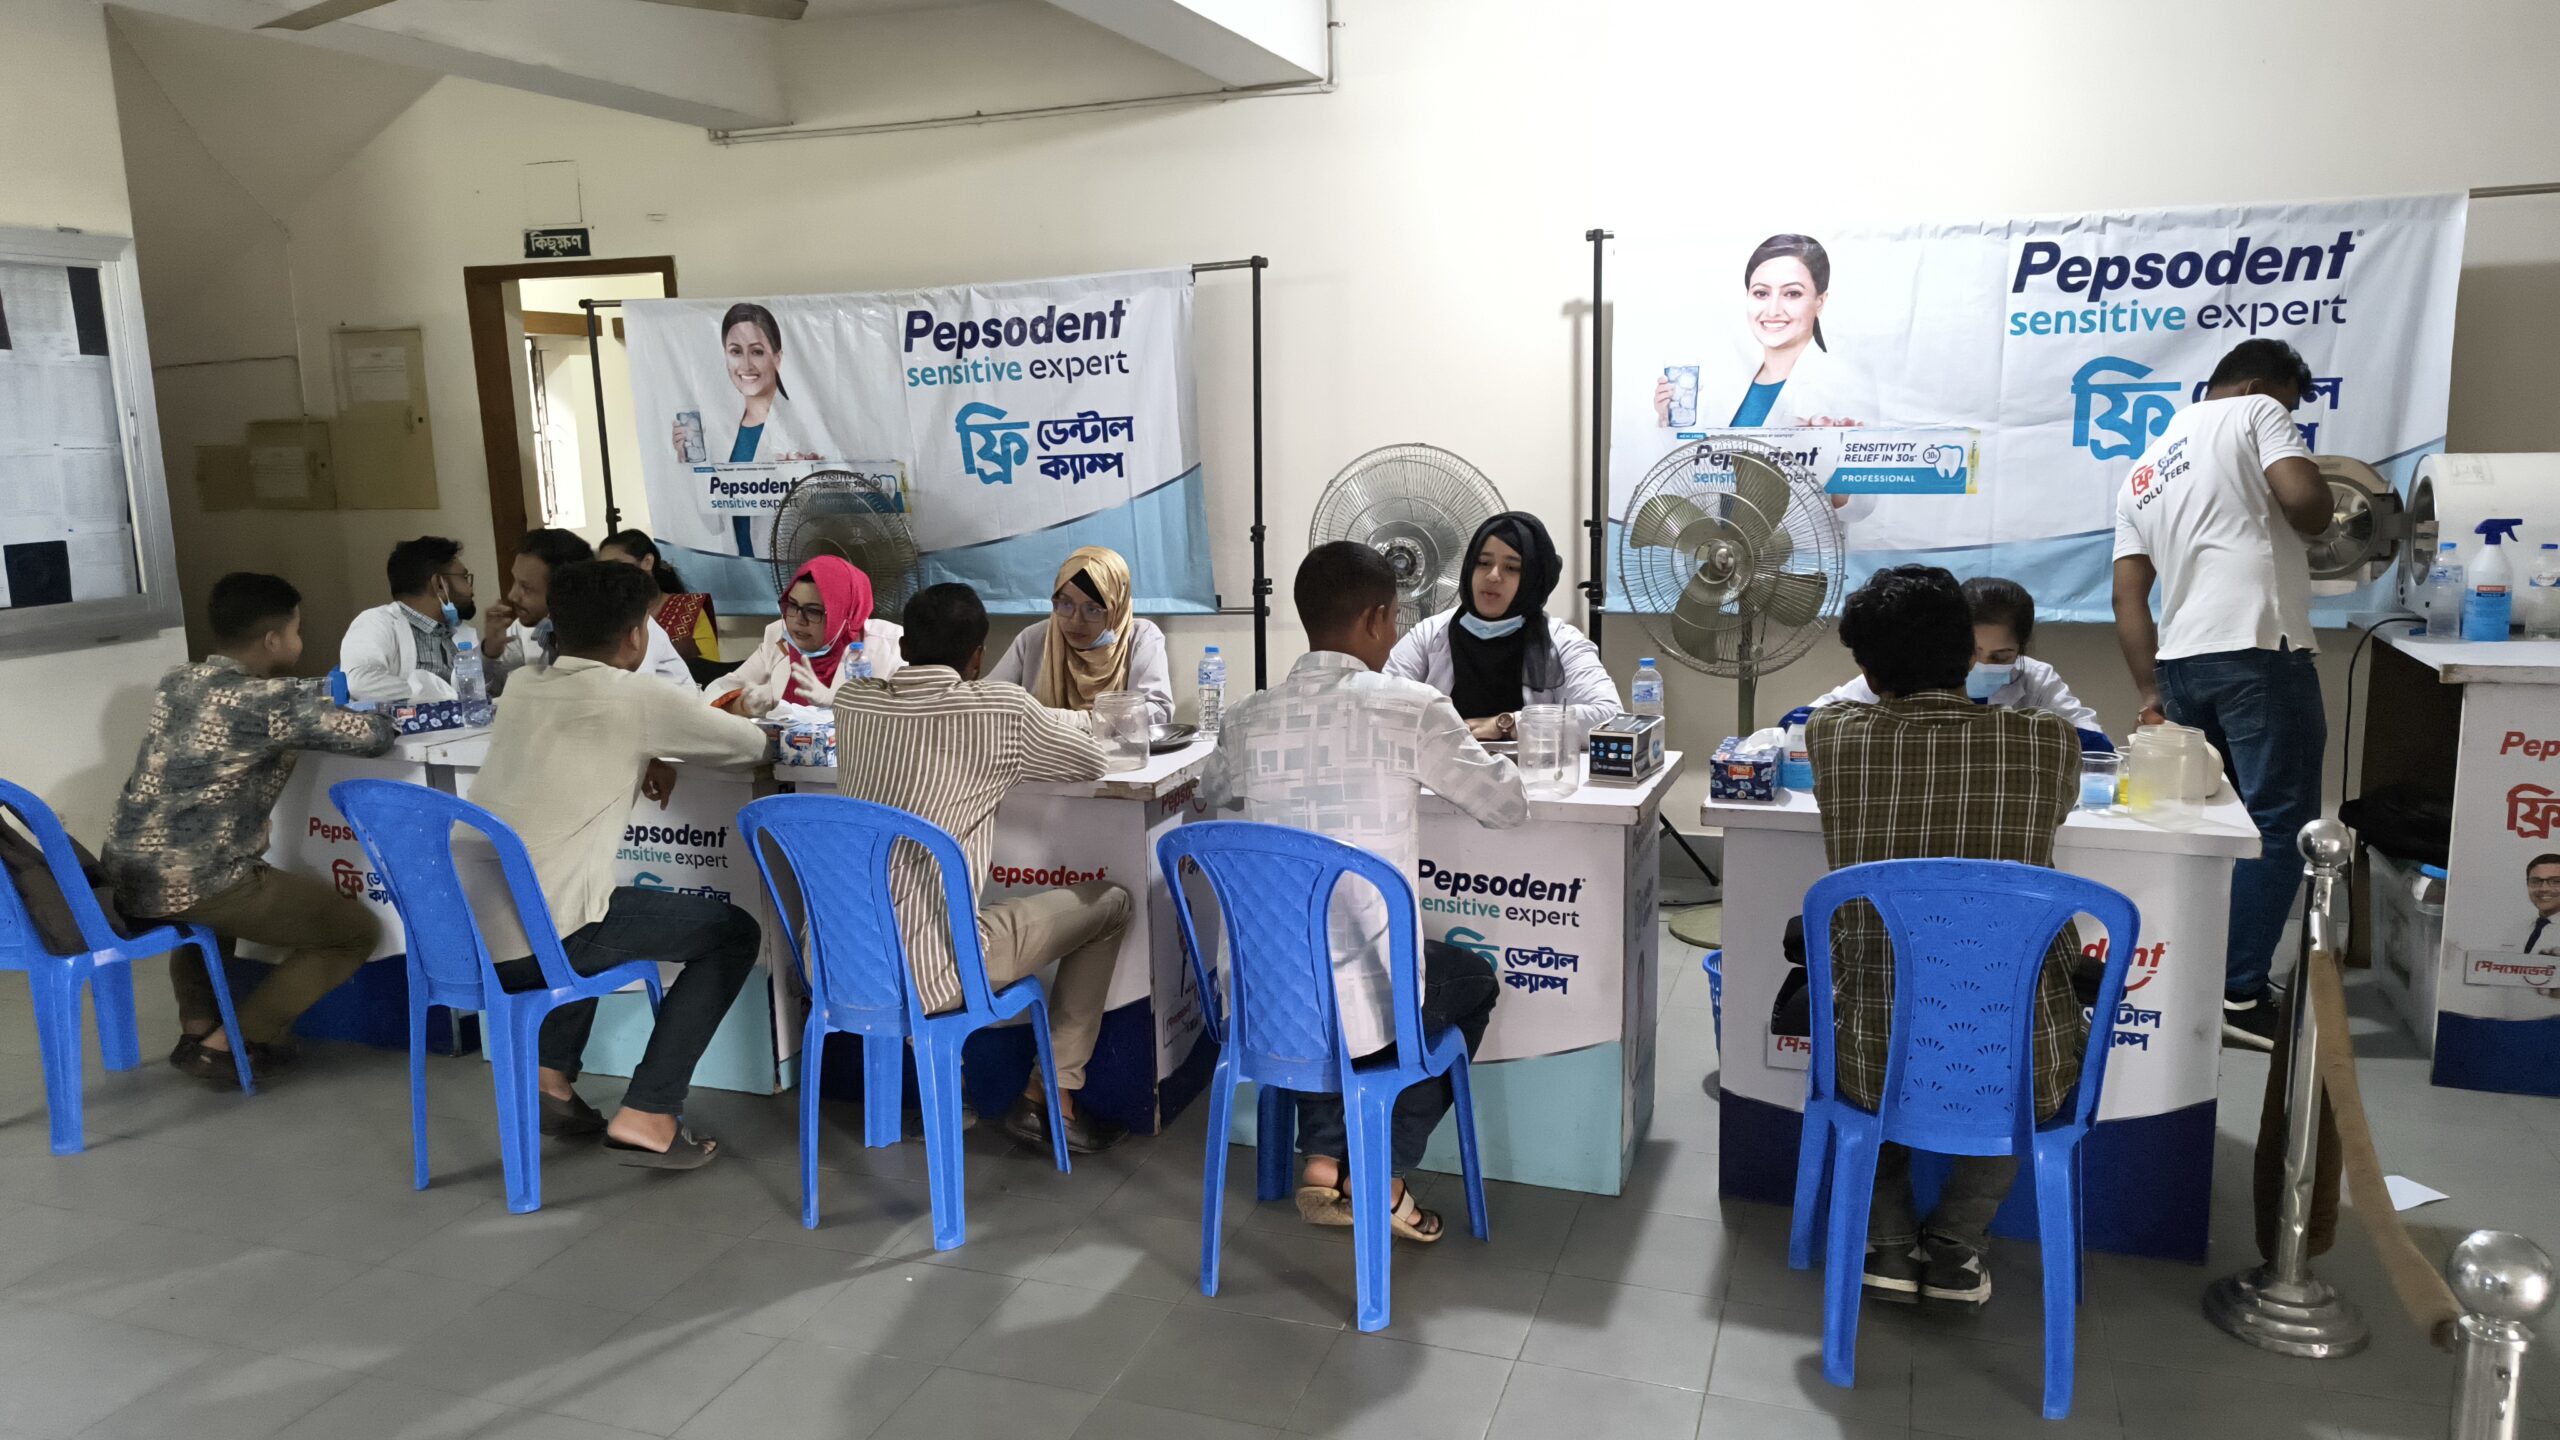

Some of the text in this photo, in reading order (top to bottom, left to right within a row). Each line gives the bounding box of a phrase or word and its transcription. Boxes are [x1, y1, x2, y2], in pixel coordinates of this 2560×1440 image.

[2011, 231, 2355, 302] Pepsodent
[2009, 295, 2347, 336] sensitive expert
[904, 299, 1127, 359] Pepsodent
[907, 350, 1130, 387] sensitive expert
[955, 402, 1134, 484] ফ্রি ডেন্টাল
[1845, 443, 1916, 452] SENSITIVITY
[1037, 452, 1124, 484] ক্যাম্প
[1844, 453, 1880, 462] RELIEF
[1881, 453, 1893, 462] IN
[1842, 475, 1916, 483] PROFESSIONAL
[711, 498, 758, 508] sensitive
[624, 824, 728, 848] epsodent
[616, 846, 728, 869] ensitive expert
[989, 861, 1106, 888] epsodent
[1419, 897, 1580, 927] ensitive expert
[1505, 947, 1579, 972] ডেন্টাল
[1504, 970, 1568, 994] ক্যাম্প
